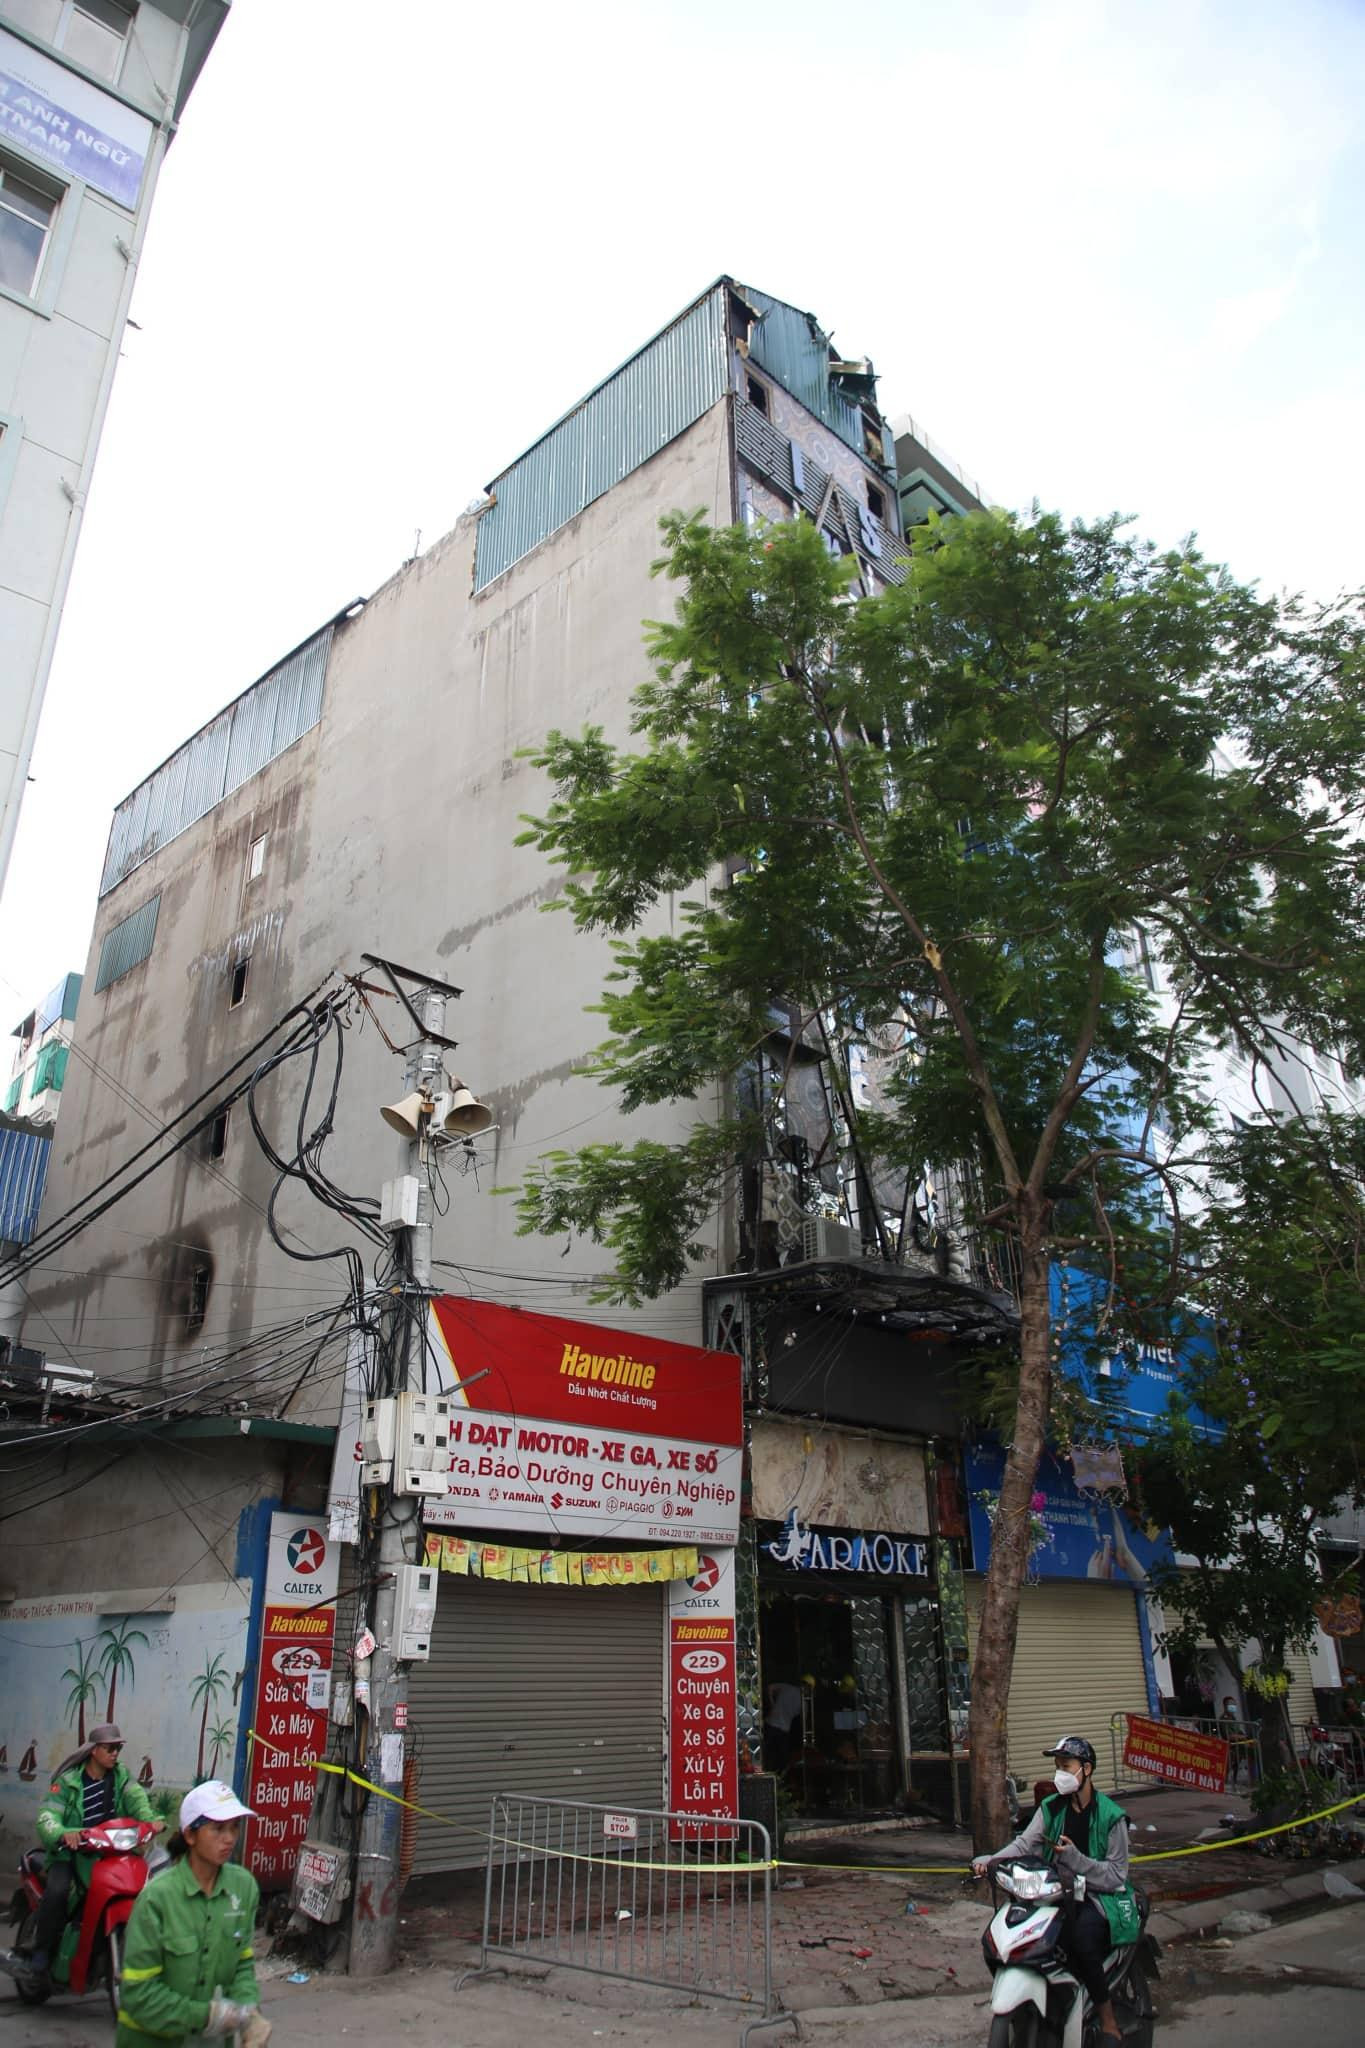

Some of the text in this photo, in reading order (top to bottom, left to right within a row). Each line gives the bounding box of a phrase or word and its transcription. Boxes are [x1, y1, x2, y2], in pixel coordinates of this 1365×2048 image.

[14, 96, 70, 133] ANH
[560, 1343, 657, 1390] Havoline
[631, 1394, 657, 1410] Lượng
[468, 1423, 513, 1453] ĐẠT
[517, 1430, 590, 1458] MOTOR
[600, 1441, 626, 1463] XE
[630, 1445, 663, 1470] GA,
[667, 1450, 690, 1471] XE
[695, 1448, 719, 1474] SỐ
[447, 1485, 481, 1498] ONDA
[526, 1462, 594, 1492] Dưỡng
[601, 1471, 671, 1497] Chuyên
[676, 1479, 736, 1506] Nghiệp
[502, 1491, 545, 1504] YAMAHA
[565, 1498, 601, 1509] SUZUKI
[443, 1510, 456, 1521] HN
[619, 1501, 655, 1514] PIAGGIO
[675, 1506, 693, 1517] SYM
[284, 1582, 323, 1595] CALTEX
[684, 1599, 720, 1608] CALTEX
[270, 1615, 328, 1633] Havoline
[677, 1625, 729, 1639] Havoline
[280, 1653, 314, 1669] 229
[689, 1655, 720, 1669] 229
[265, 1678, 289, 1703] Sửa
[677, 1677, 729, 1698] Chuyên
[683, 1703, 724, 1720] Xe Ga
[269, 1713, 315, 1740] Xe Máy
[683, 1726, 726, 1746] Xe Số
[708, 1755, 725, 1777] Lý
[1127, 1753, 1164, 1774] KHÔNG
[256, 1778, 290, 1808] Bằng
[257, 1813, 310, 1842] Thay Th
[251, 1851, 277, 1877] Phụ
